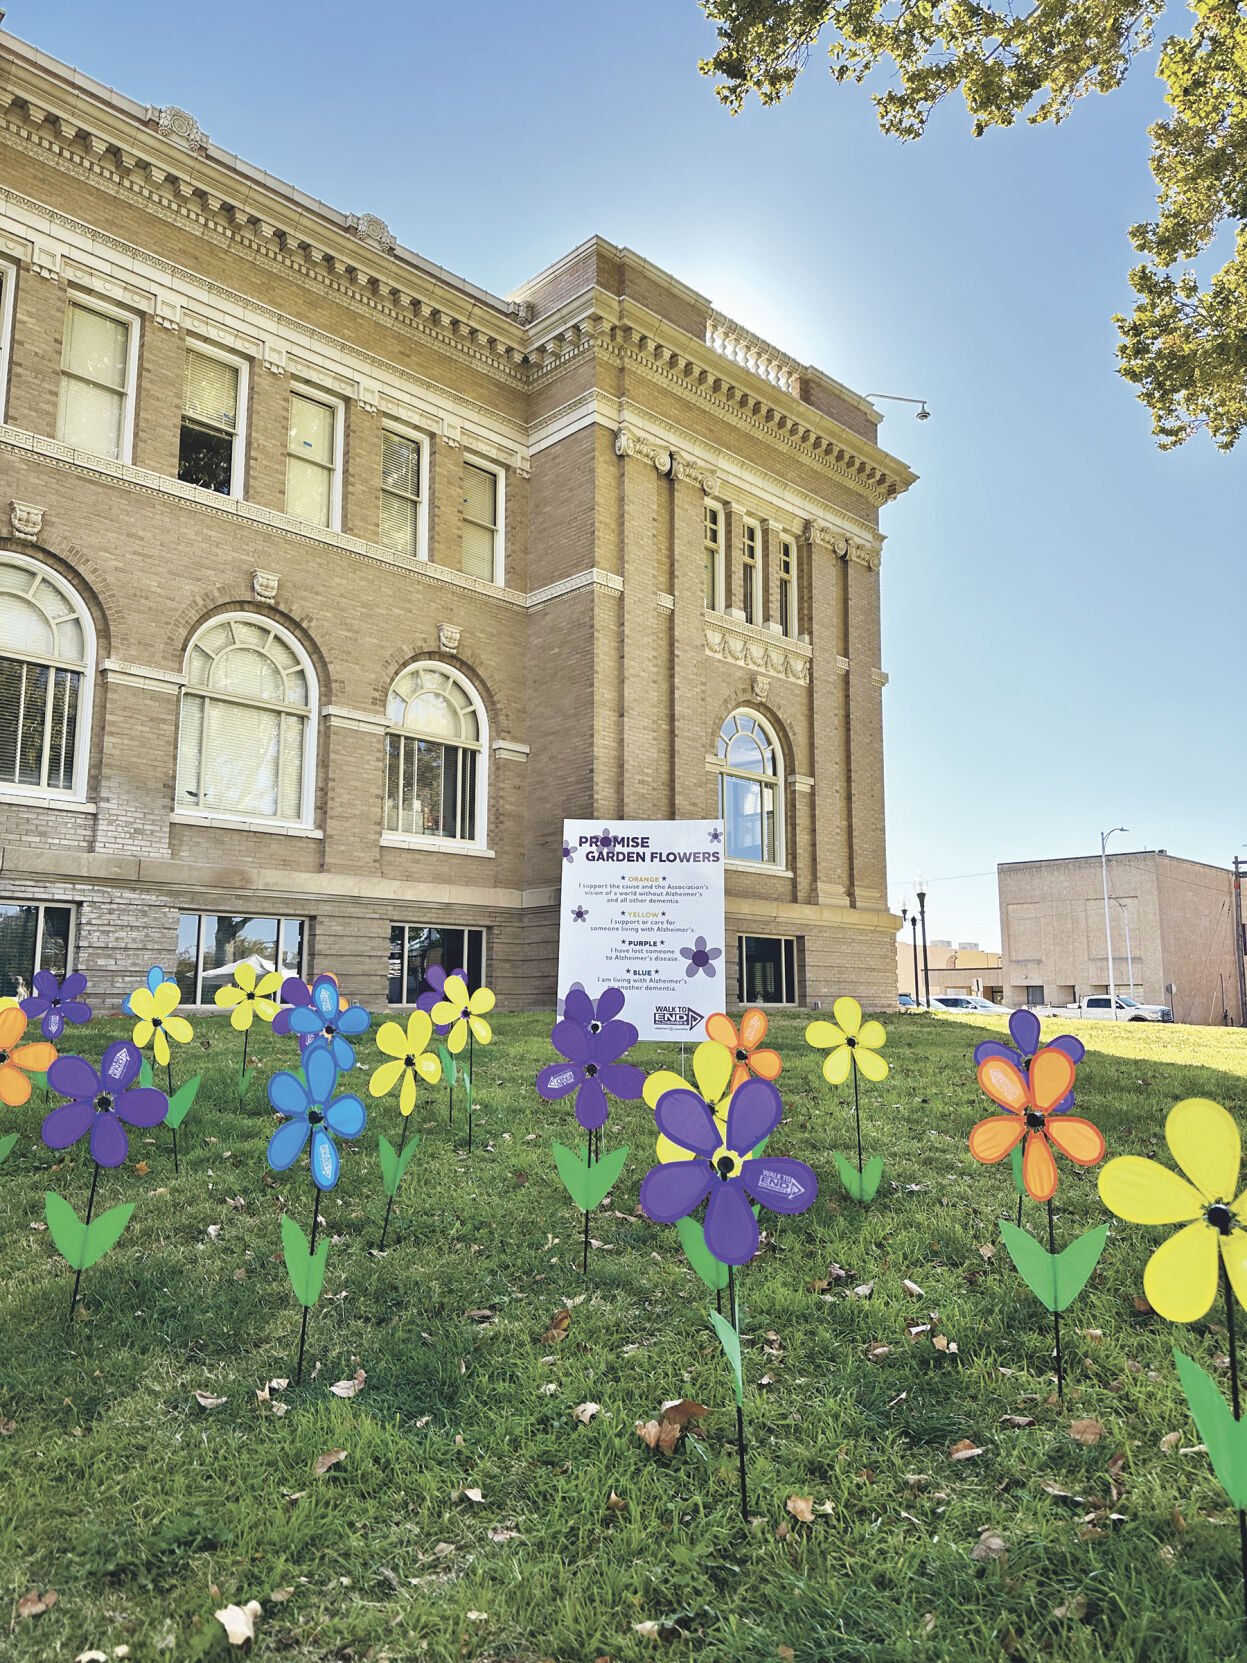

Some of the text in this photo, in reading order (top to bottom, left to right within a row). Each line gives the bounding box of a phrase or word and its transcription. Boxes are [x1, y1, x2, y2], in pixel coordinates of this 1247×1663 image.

[579, 836, 650, 848] PROMISE
[585, 851, 720, 863] GARDEN FLOWERS
[655, 1013, 687, 1021] END
[762, 1169, 781, 1178] WALK
[761, 1176, 790, 1189] END
